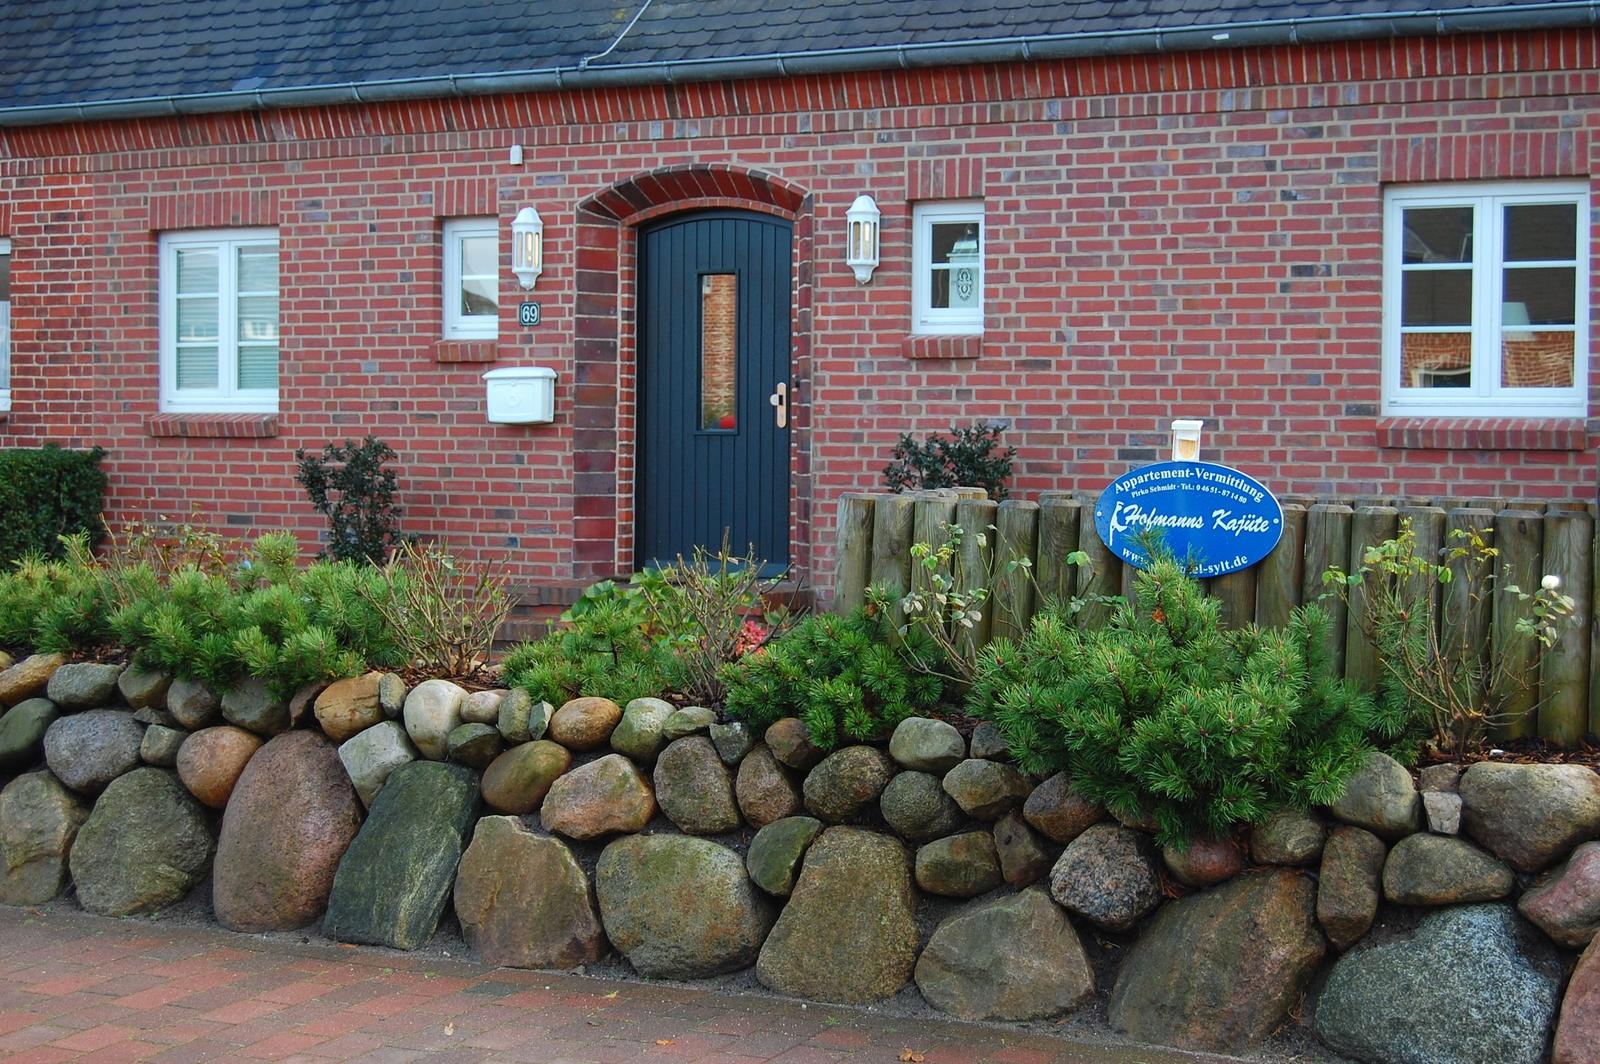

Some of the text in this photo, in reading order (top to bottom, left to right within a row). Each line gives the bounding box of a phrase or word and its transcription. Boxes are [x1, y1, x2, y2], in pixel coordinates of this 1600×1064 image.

[522, 305, 538, 322] 69
[1115, 467, 1265, 503] Appartement-Vermittlung
[1131, 488, 1149, 498] Pirko
[1149, 483, 1176, 493] Schmidt
[1123, 504, 1270, 537] Hofmanns Kajüte
